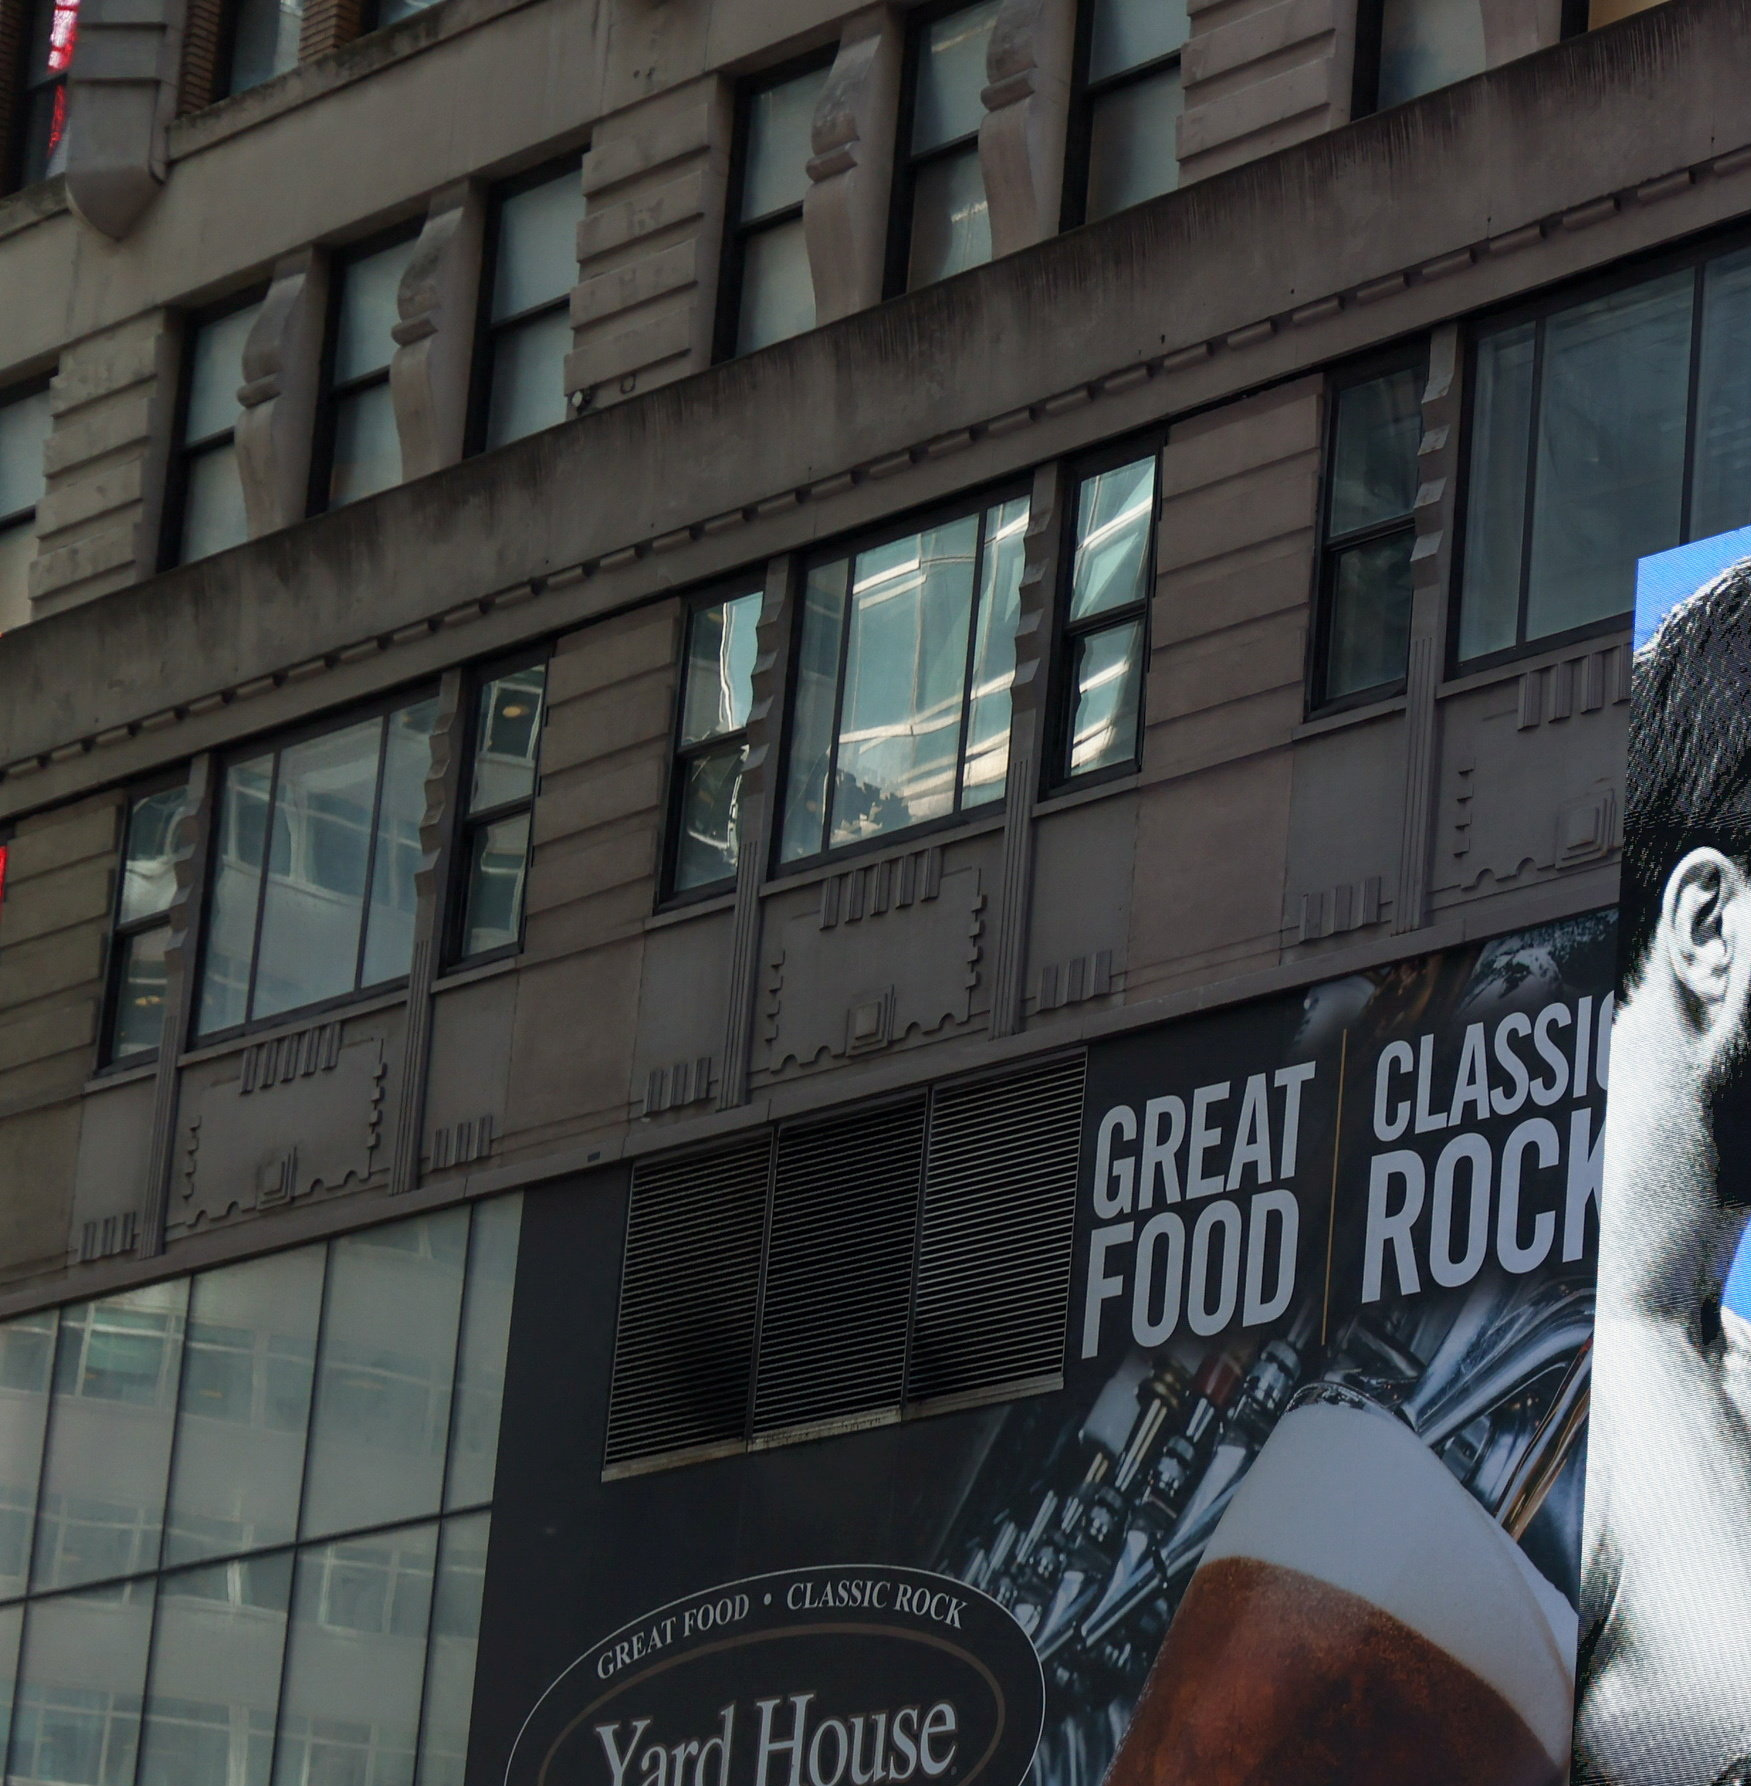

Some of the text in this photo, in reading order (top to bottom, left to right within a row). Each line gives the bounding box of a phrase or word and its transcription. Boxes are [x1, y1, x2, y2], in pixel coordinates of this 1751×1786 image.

[1091, 1060, 1317, 1220] GREAT
[1080, 1189, 1300, 1361] FOOD
[596, 1579, 969, 1681] GREAT FOOD CLASSIC ROCK
